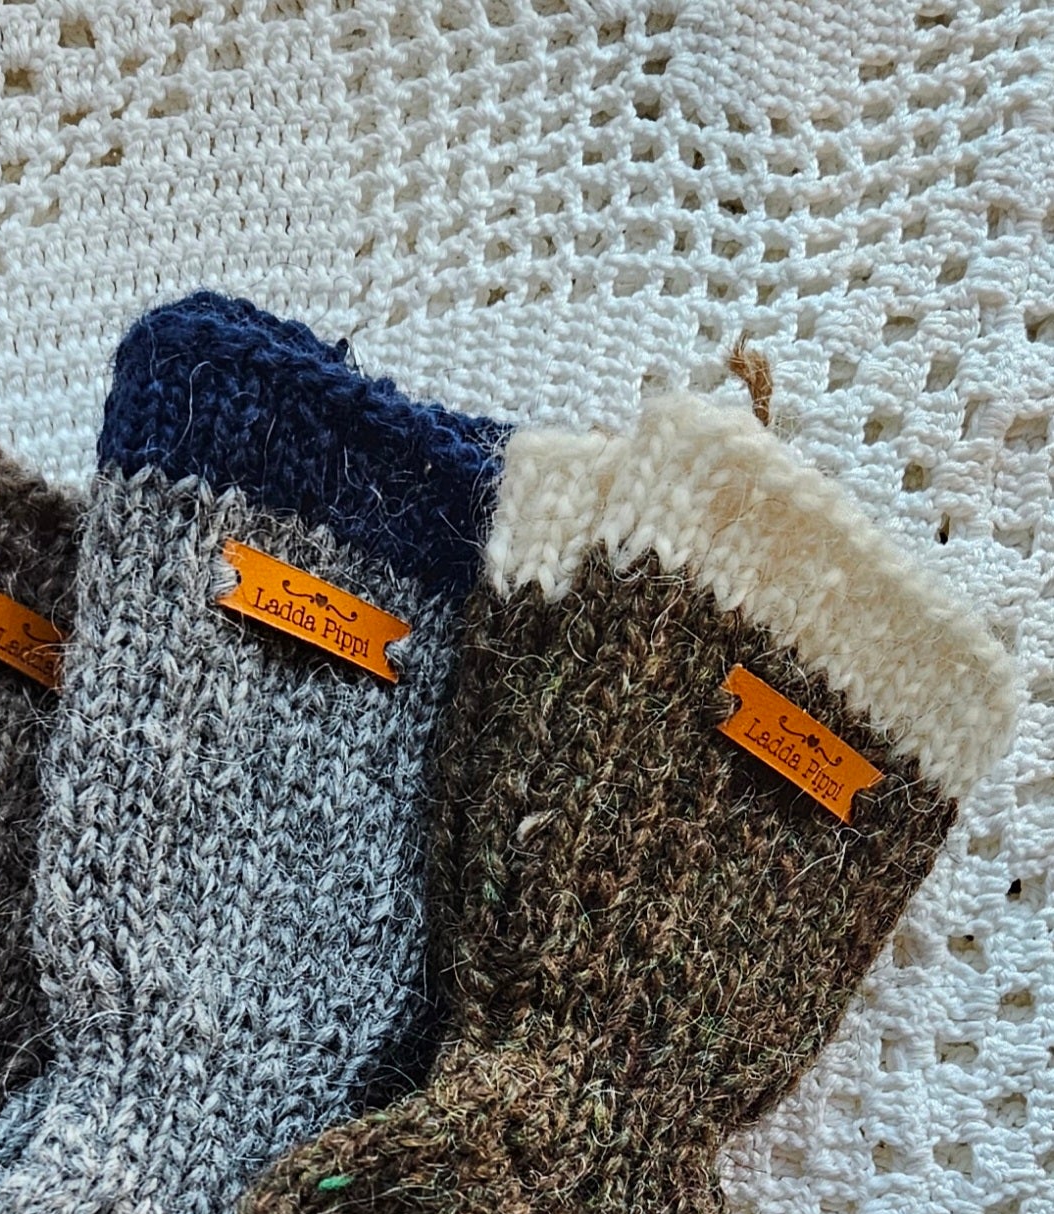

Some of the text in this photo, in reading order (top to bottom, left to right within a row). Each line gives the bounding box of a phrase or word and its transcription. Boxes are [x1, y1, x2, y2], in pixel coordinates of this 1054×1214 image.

[253, 587, 370, 658] Ladda Pippi
[743, 717, 845, 801] Ladda Pippi
